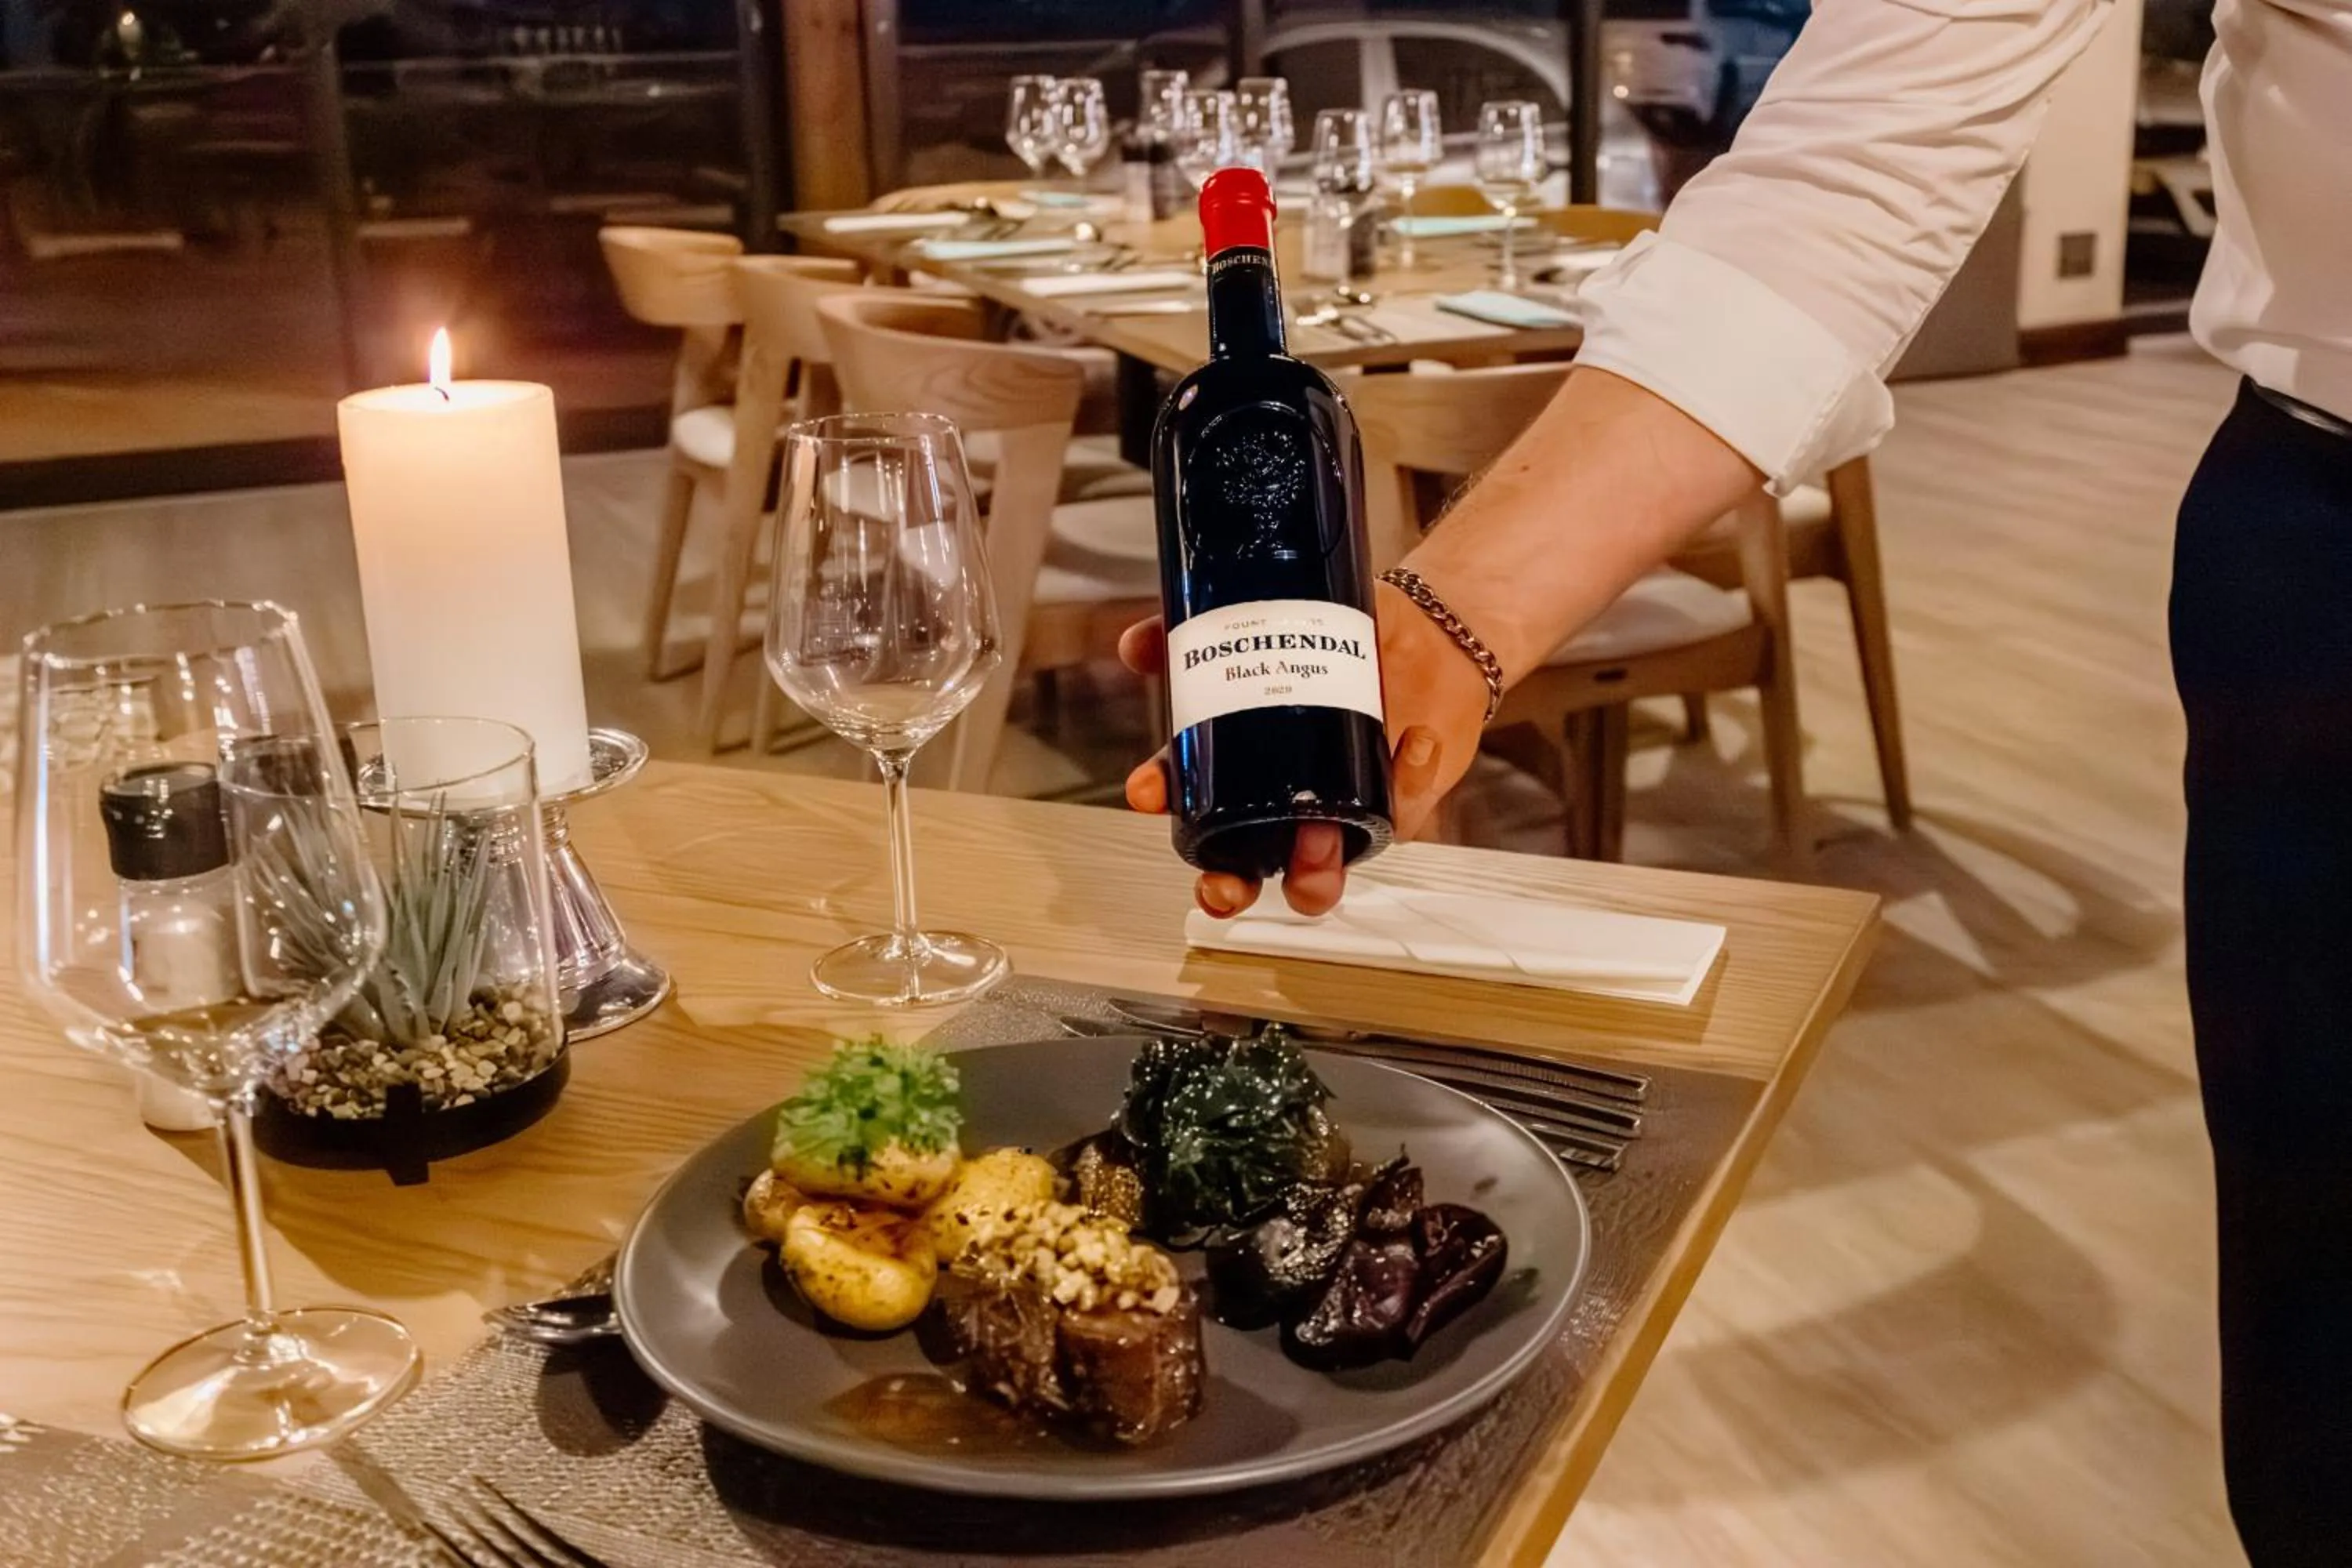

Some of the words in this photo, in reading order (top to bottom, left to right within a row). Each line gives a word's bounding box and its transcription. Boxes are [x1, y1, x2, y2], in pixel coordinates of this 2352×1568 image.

[1212, 254, 1270, 274] BOSCHEN
[1184, 634, 1367, 671] BOSCHENDAL
[1225, 662, 1270, 681] Black
[1276, 661, 1329, 678] Angus
